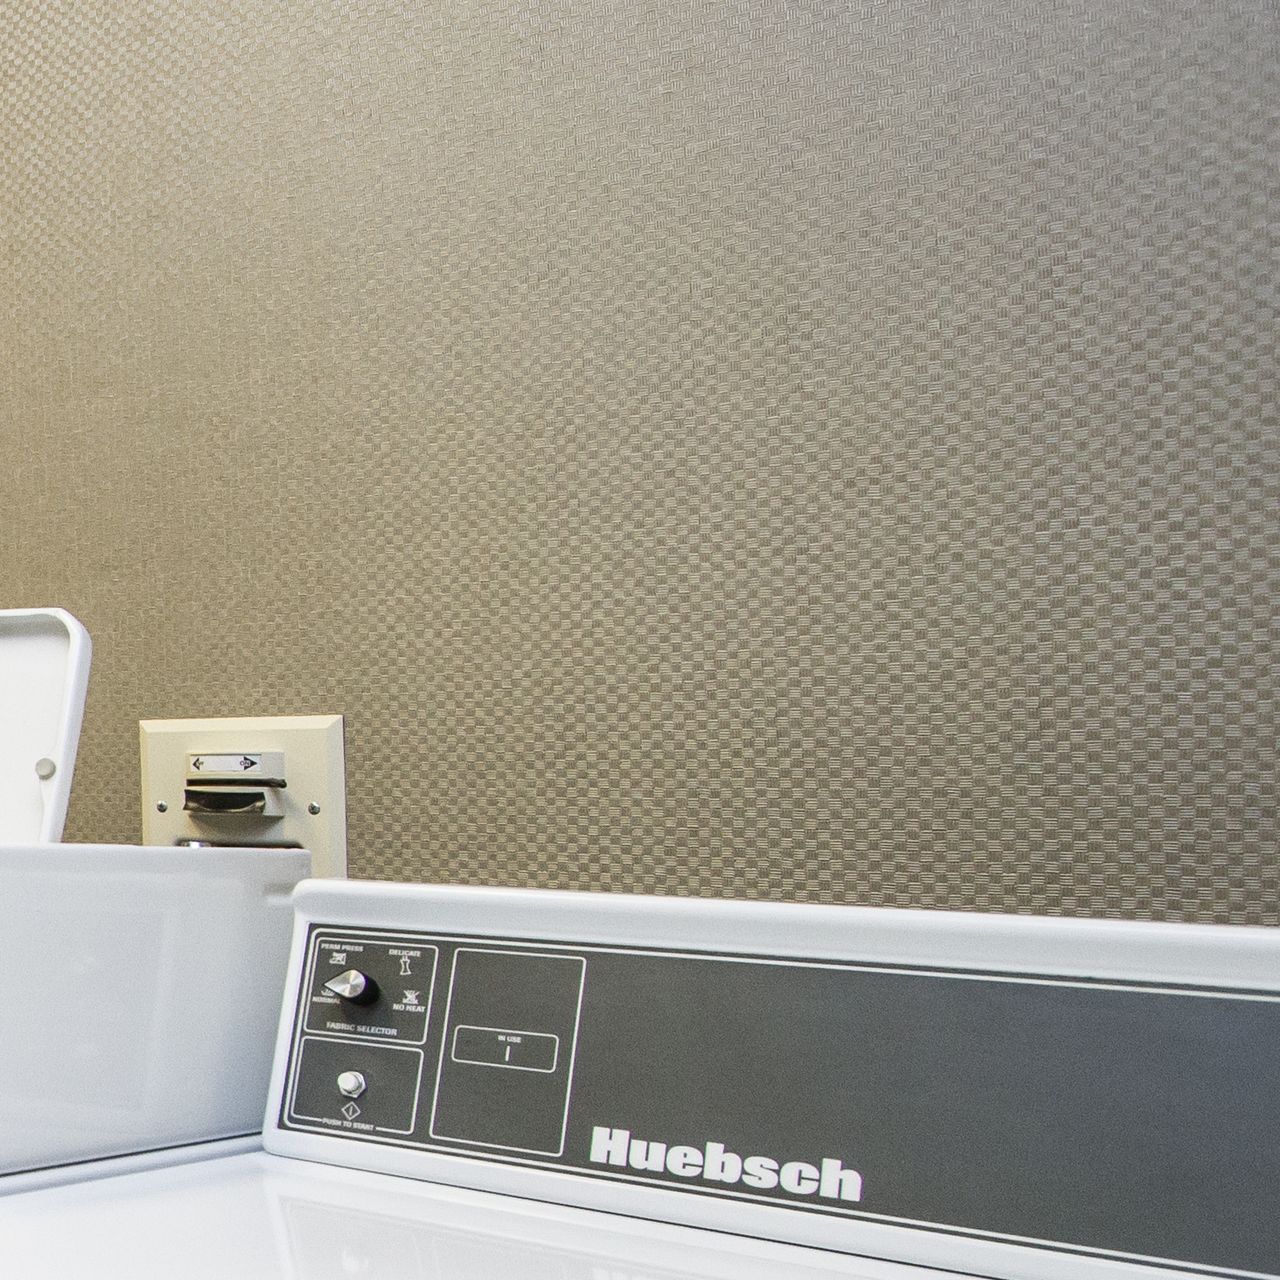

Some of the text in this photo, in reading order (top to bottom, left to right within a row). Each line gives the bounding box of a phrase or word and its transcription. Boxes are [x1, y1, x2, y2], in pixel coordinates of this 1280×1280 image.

[321, 943, 364, 953] PERM PRESS
[389, 949, 421, 957] DELICATE
[312, 996, 341, 1005] NORMAL
[392, 1003, 426, 1013] NO HEAT
[326, 1022, 398, 1036] FABRIC SELECTOR
[497, 1034, 522, 1044] IN USE
[322, 1117, 375, 1131] PUSH TO START
[589, 1125, 863, 1203] Huebsch
